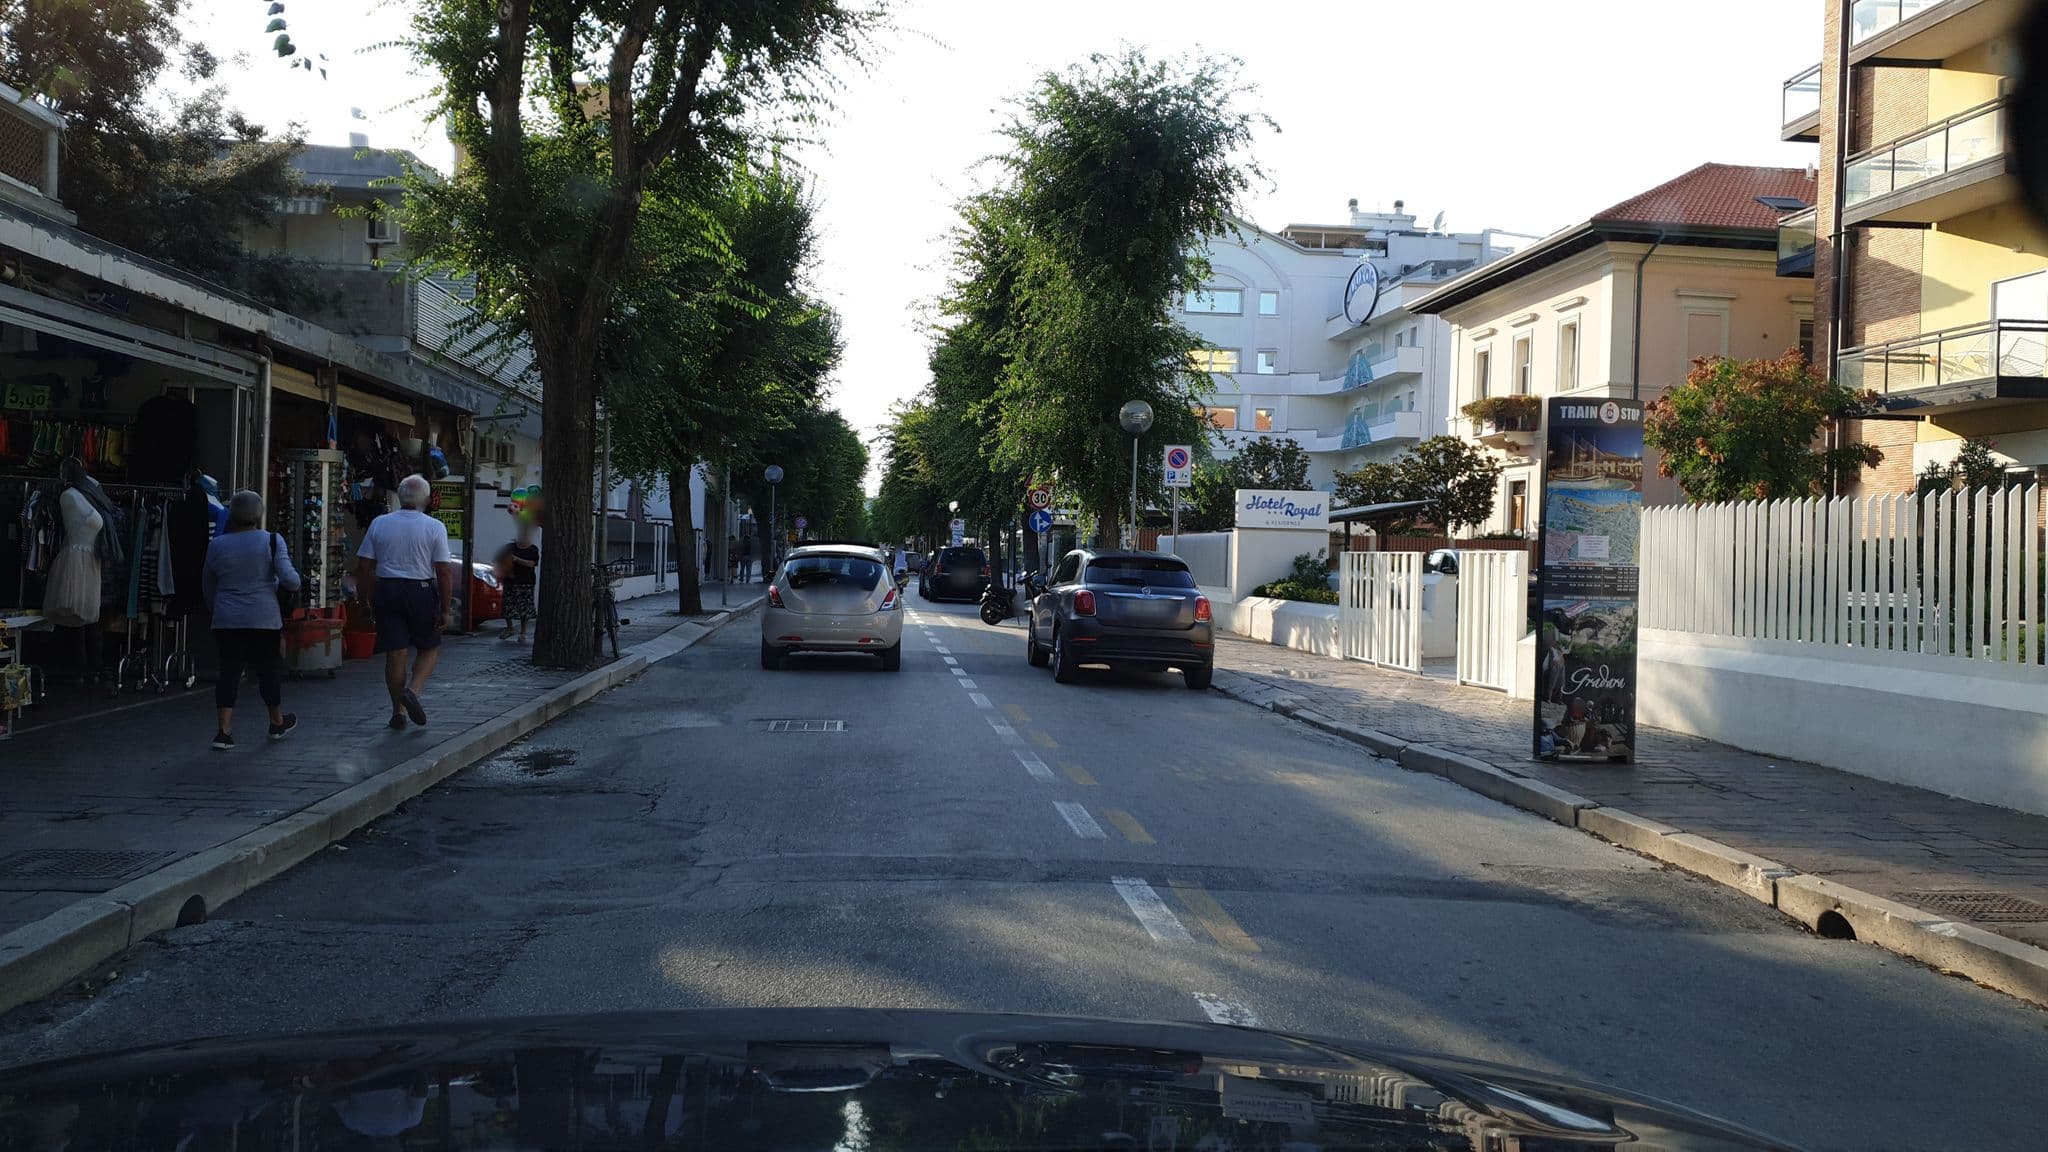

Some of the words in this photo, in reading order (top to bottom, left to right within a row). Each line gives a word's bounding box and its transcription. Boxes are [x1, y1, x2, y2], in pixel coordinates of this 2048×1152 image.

[1560, 405, 1598, 419] TRAIN
[1620, 407, 1640, 421] STOP
[1034, 493, 1047, 504] 30
[1245, 495, 1285, 510] Hotel
[1283, 502, 1322, 521] Royal
[1560, 664, 1626, 695] Gradara
